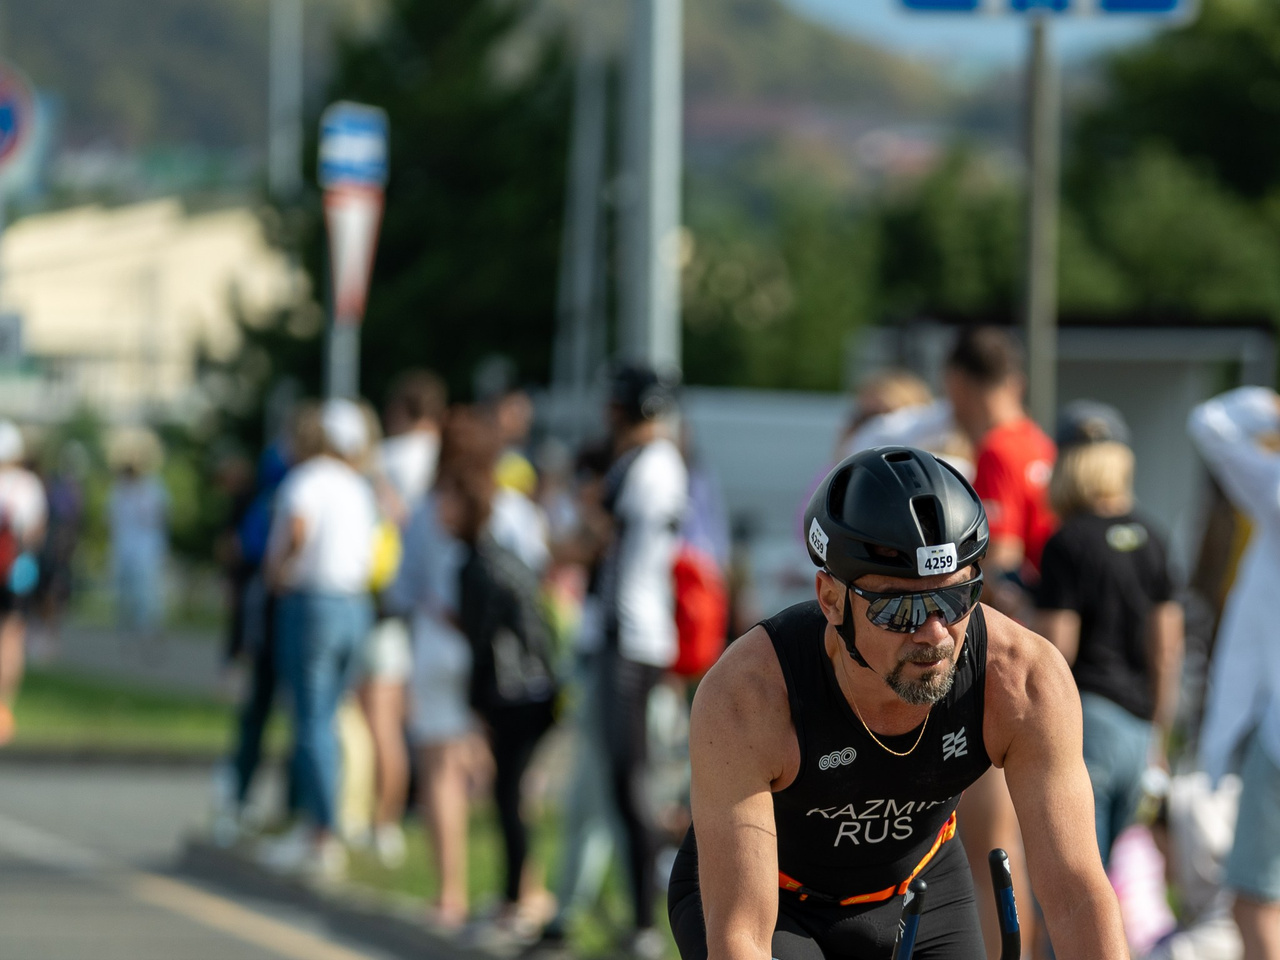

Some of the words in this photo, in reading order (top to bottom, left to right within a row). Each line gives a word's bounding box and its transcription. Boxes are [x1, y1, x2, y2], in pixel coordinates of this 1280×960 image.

[811, 531, 824, 555] 4259
[924, 555, 953, 571] 4259
[833, 816, 914, 847] RUS
